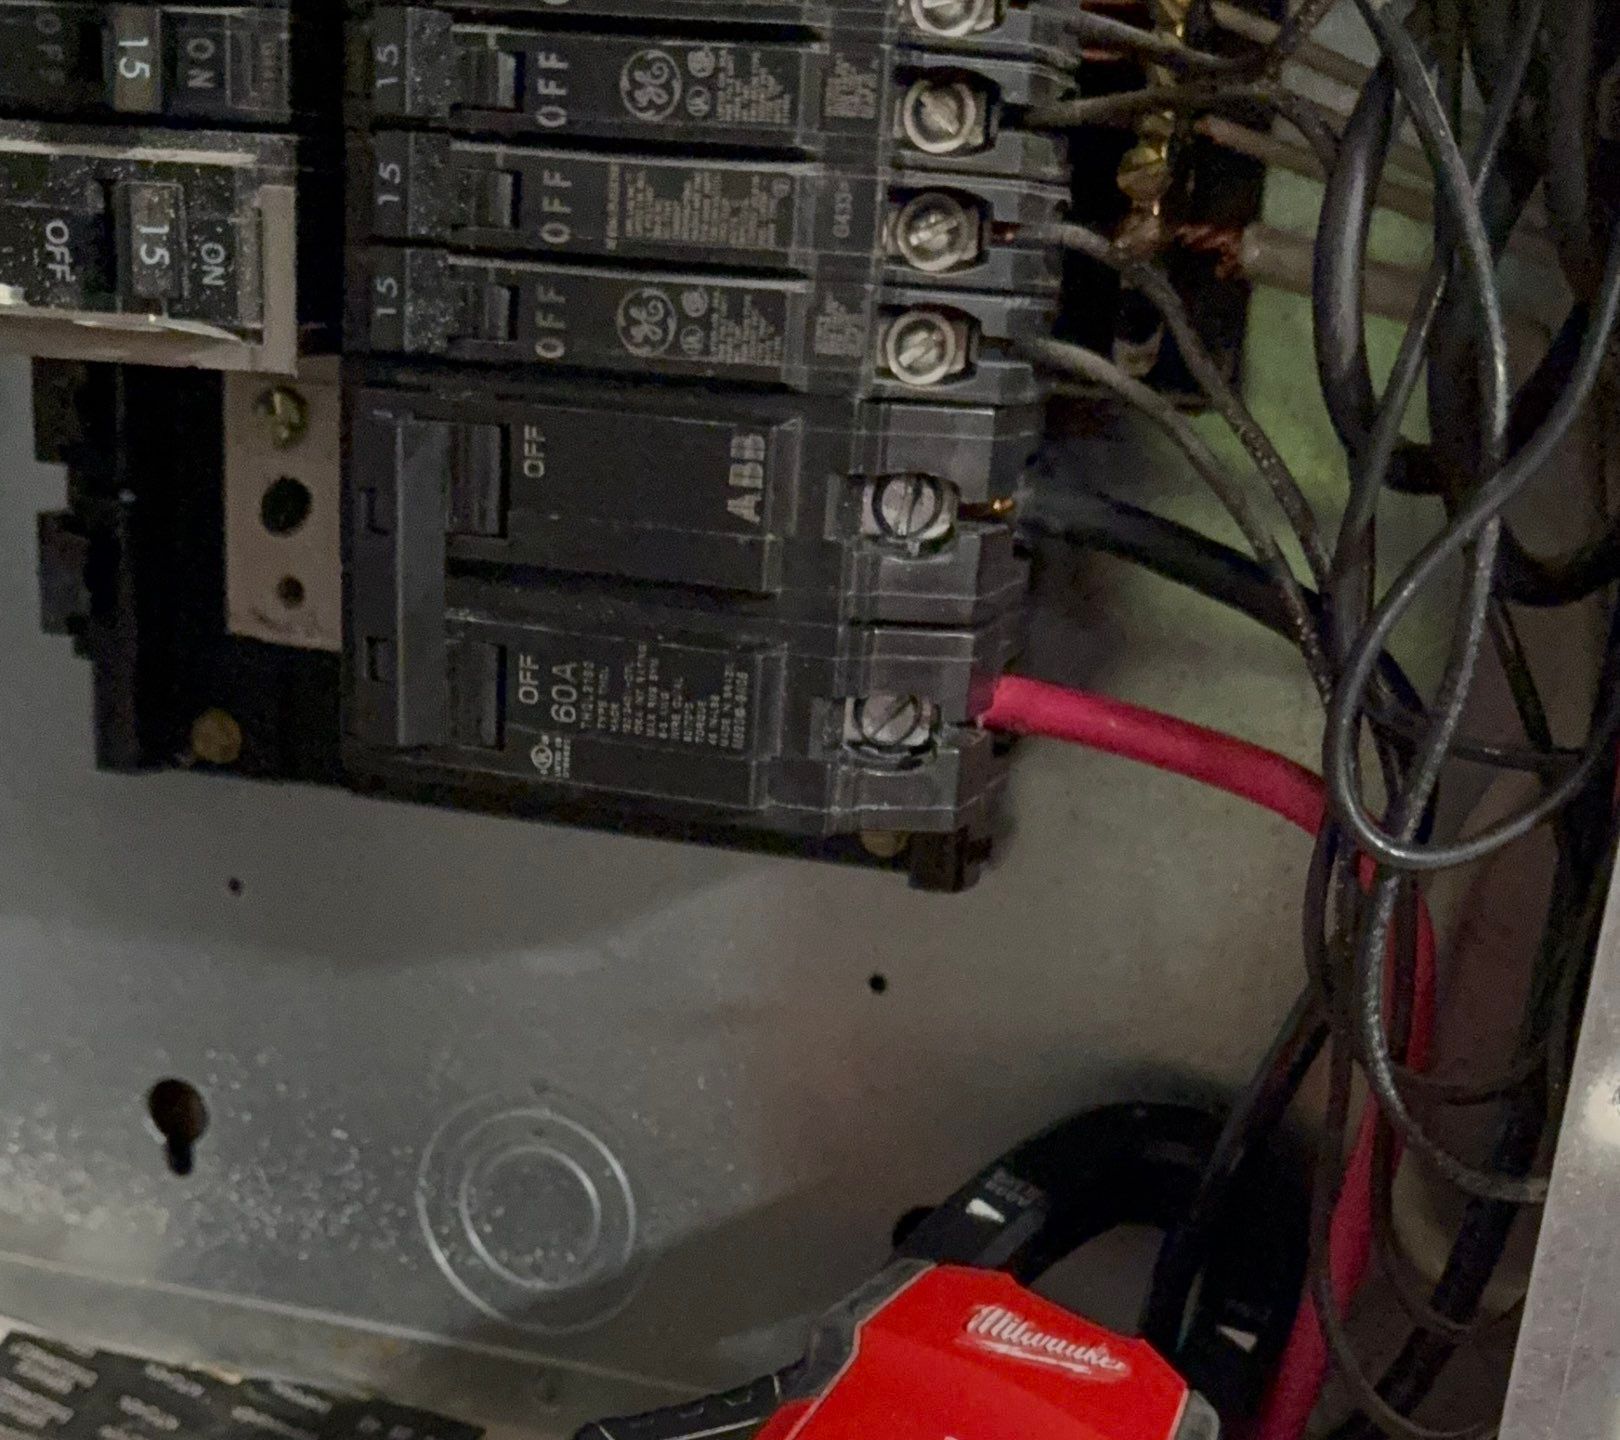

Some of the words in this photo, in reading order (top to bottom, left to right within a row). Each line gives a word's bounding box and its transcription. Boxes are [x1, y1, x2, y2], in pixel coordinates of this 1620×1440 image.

[118, 36, 151, 80] 15
[186, 36, 216, 90] ON
[375, 42, 399, 88] 15
[535, 50, 569, 129] OFF
[377, 161, 401, 205] 15
[540, 167, 573, 245] OFF
[44, 218, 76, 283] OFF
[138, 222, 170, 267] 15
[201, 241, 226, 287] ON
[375, 276, 399, 318] 15
[533, 286, 567, 360] OFF
[522, 424, 546, 479] OFF
[726, 431, 766, 525] ABB
[517, 653, 541, 706] OFF
[549, 660, 579, 725] 60A
[962, 1303, 1129, 1376] Milwaukee
